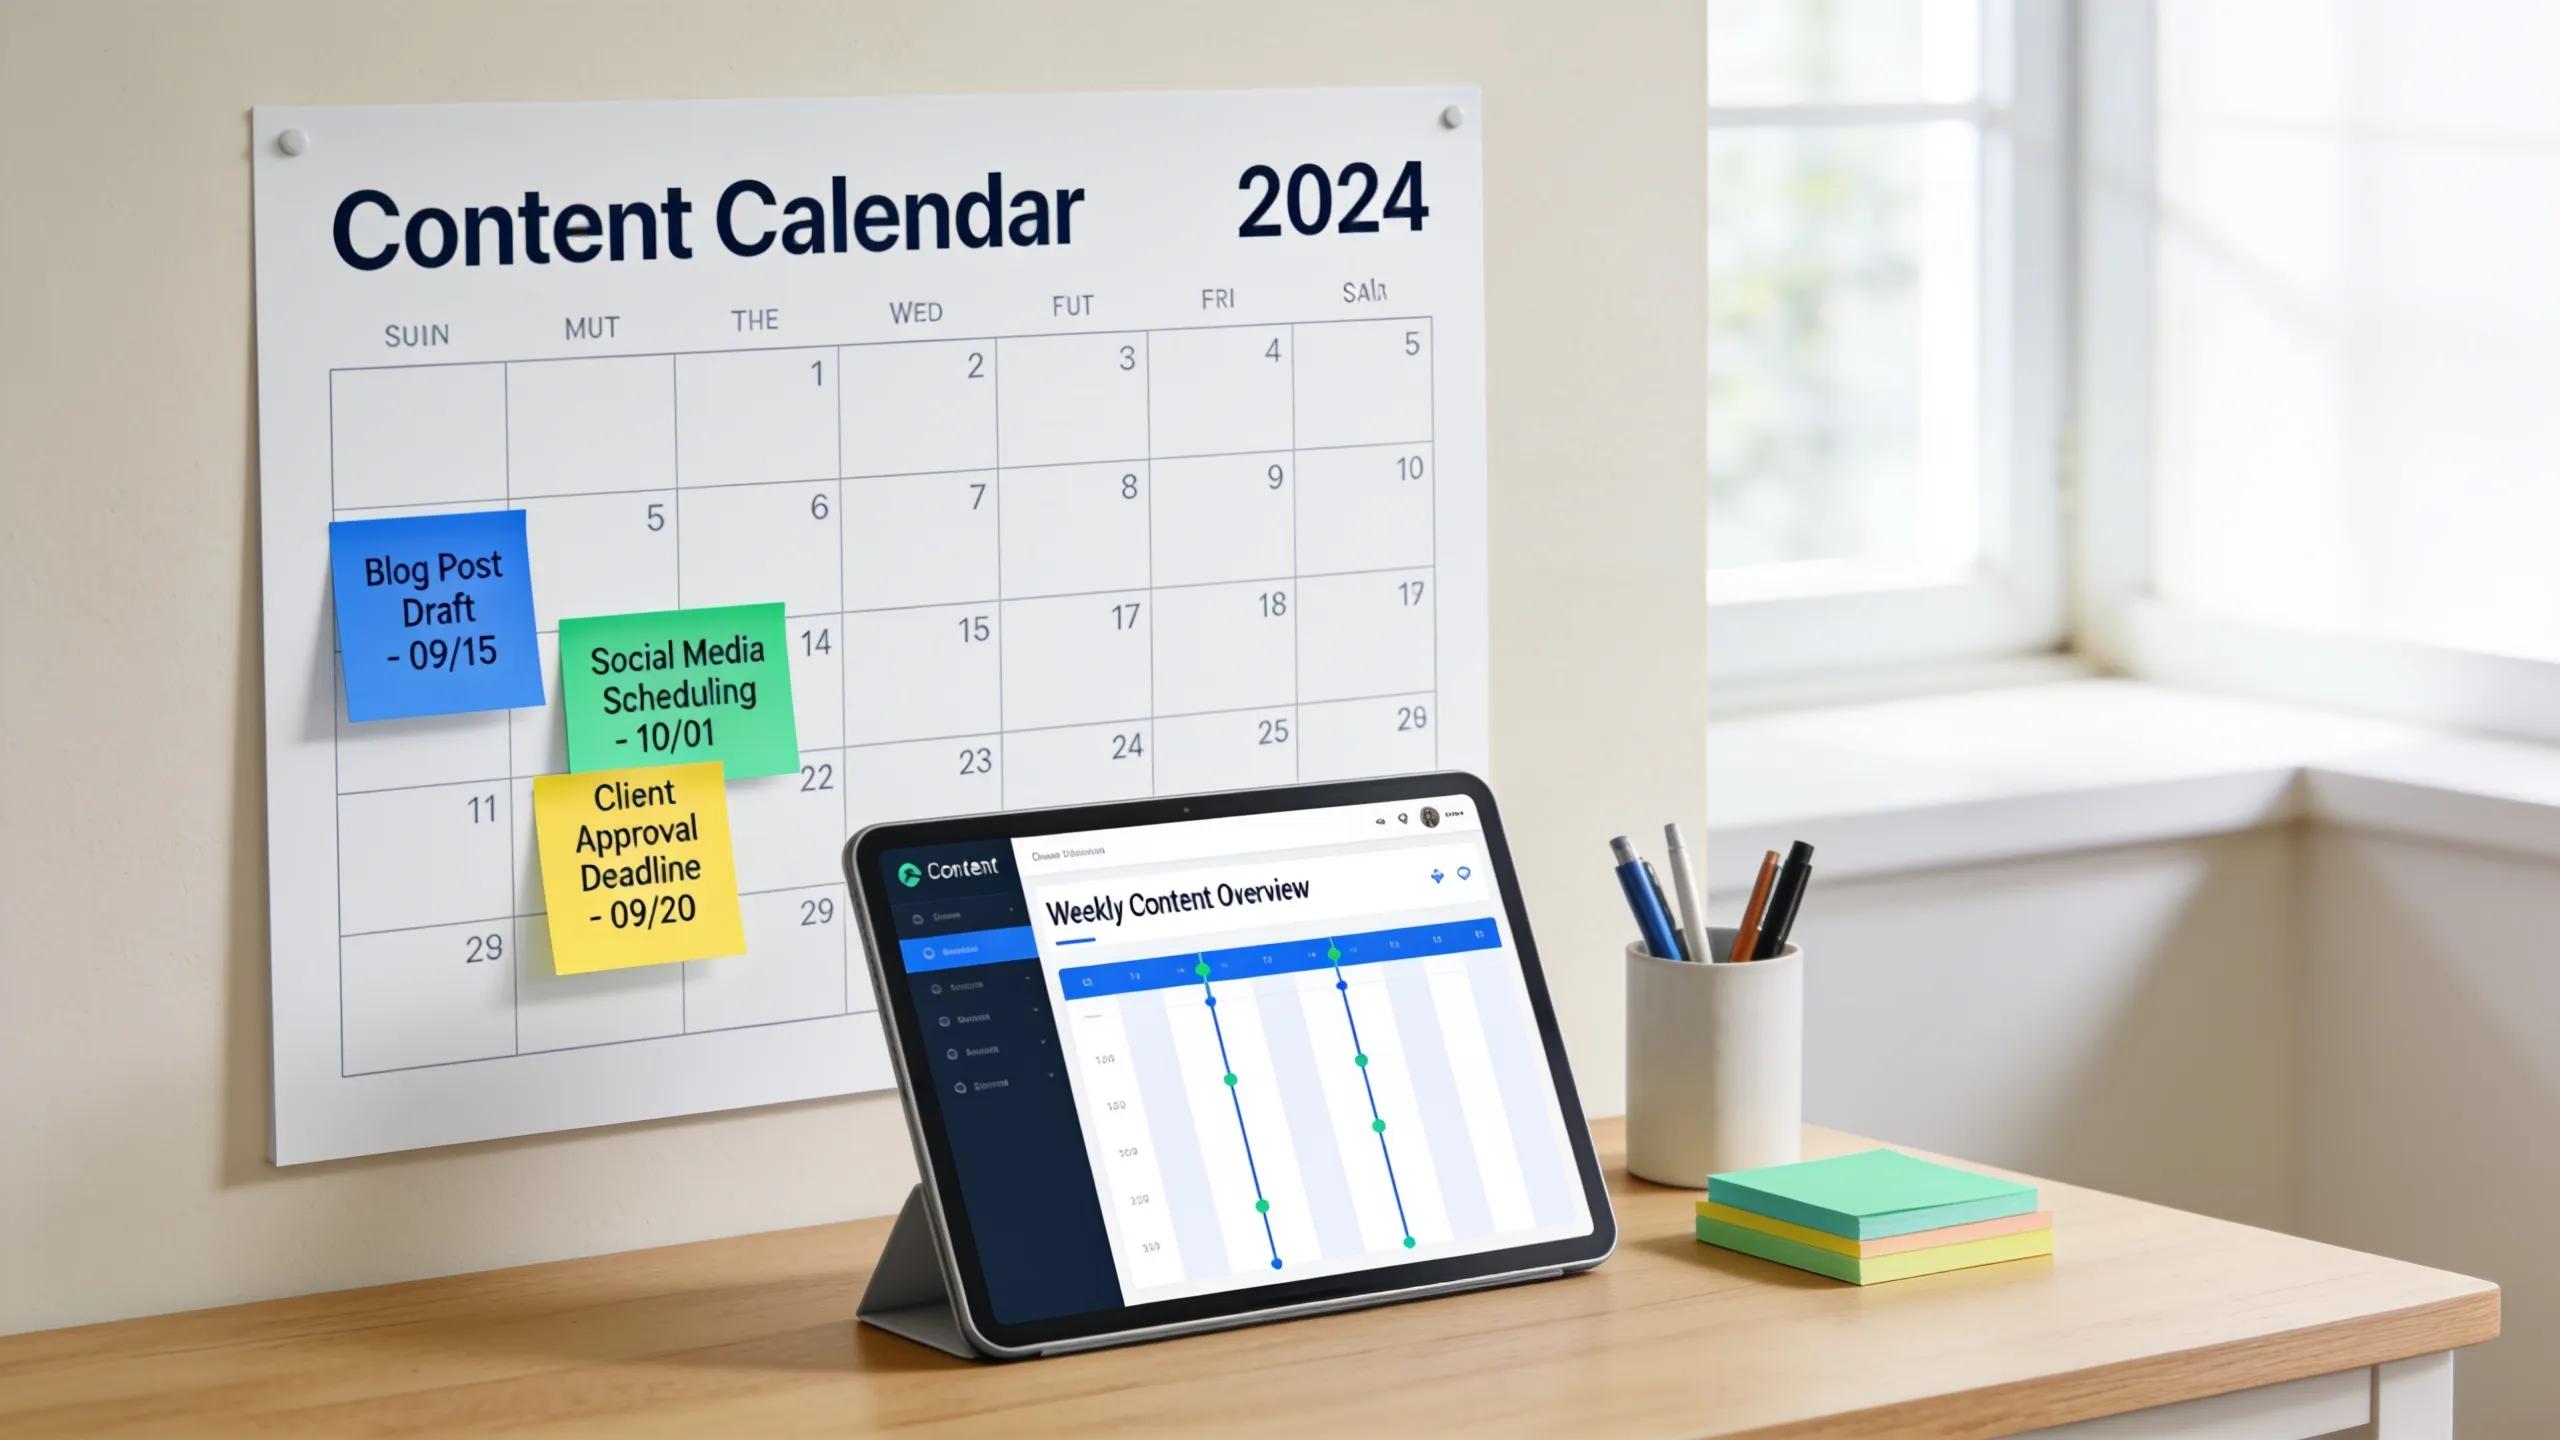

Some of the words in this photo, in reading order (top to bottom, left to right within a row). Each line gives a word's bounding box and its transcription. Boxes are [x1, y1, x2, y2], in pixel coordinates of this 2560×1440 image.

[333, 188, 692, 271] Content
[717, 172, 1084, 257] Calendar
[1239, 161, 1429, 237] 2024
[1053, 295, 1094, 317] FUT
[1202, 288, 1234, 309] FRI
[731, 309, 778, 331] THE
[890, 301, 943, 324] WED
[385, 324, 448, 347] SUIN
[566, 316, 620, 340] MUT
[1265, 338, 1281, 362] 4
[1406, 331, 1420, 356] 5
[968, 353, 984, 378] 2
[1120, 345, 1135, 371] 3
[812, 360, 821, 386] 1
[1268, 464, 1283, 489] 9
[1397, 456, 1423, 480] 10
[970, 484, 986, 510] 7
[1122, 474, 1137, 499] 8
[648, 504, 664, 531] 5
[811, 494, 828, 520] 6
[366, 555, 429, 590] Blog
[438, 551, 503, 581] Post
[403, 592, 476, 628] Draft
[1112, 603, 1140, 630] 17
[1259, 592, 1286, 617] 18
[802, 629, 831, 656] 14
[959, 616, 989, 643] 15
[410, 635, 496, 672] 09/15
[592, 640, 674, 675] Social
[683, 635, 764, 668] Media
[603, 677, 757, 714] Scheduling
[637, 718, 713, 754] 10/01
[1259, 719, 1288, 745] 25
[1113, 733, 1144, 760] 24
[960, 748, 992, 775] 23
[801, 764, 833, 792] 22
[468, 795, 494, 823] 11
[595, 780, 676, 811] Client
[576, 813, 698, 857] Approval
[581, 856, 701, 892] Deadline
[928, 858, 998, 879] Content
[611, 894, 695, 930] 09/20
[801, 898, 833, 926] 29
[1046, 895, 1123, 927] Weekly
[1130, 886, 1214, 917] Content
[1217, 878, 1309, 906] Overview
